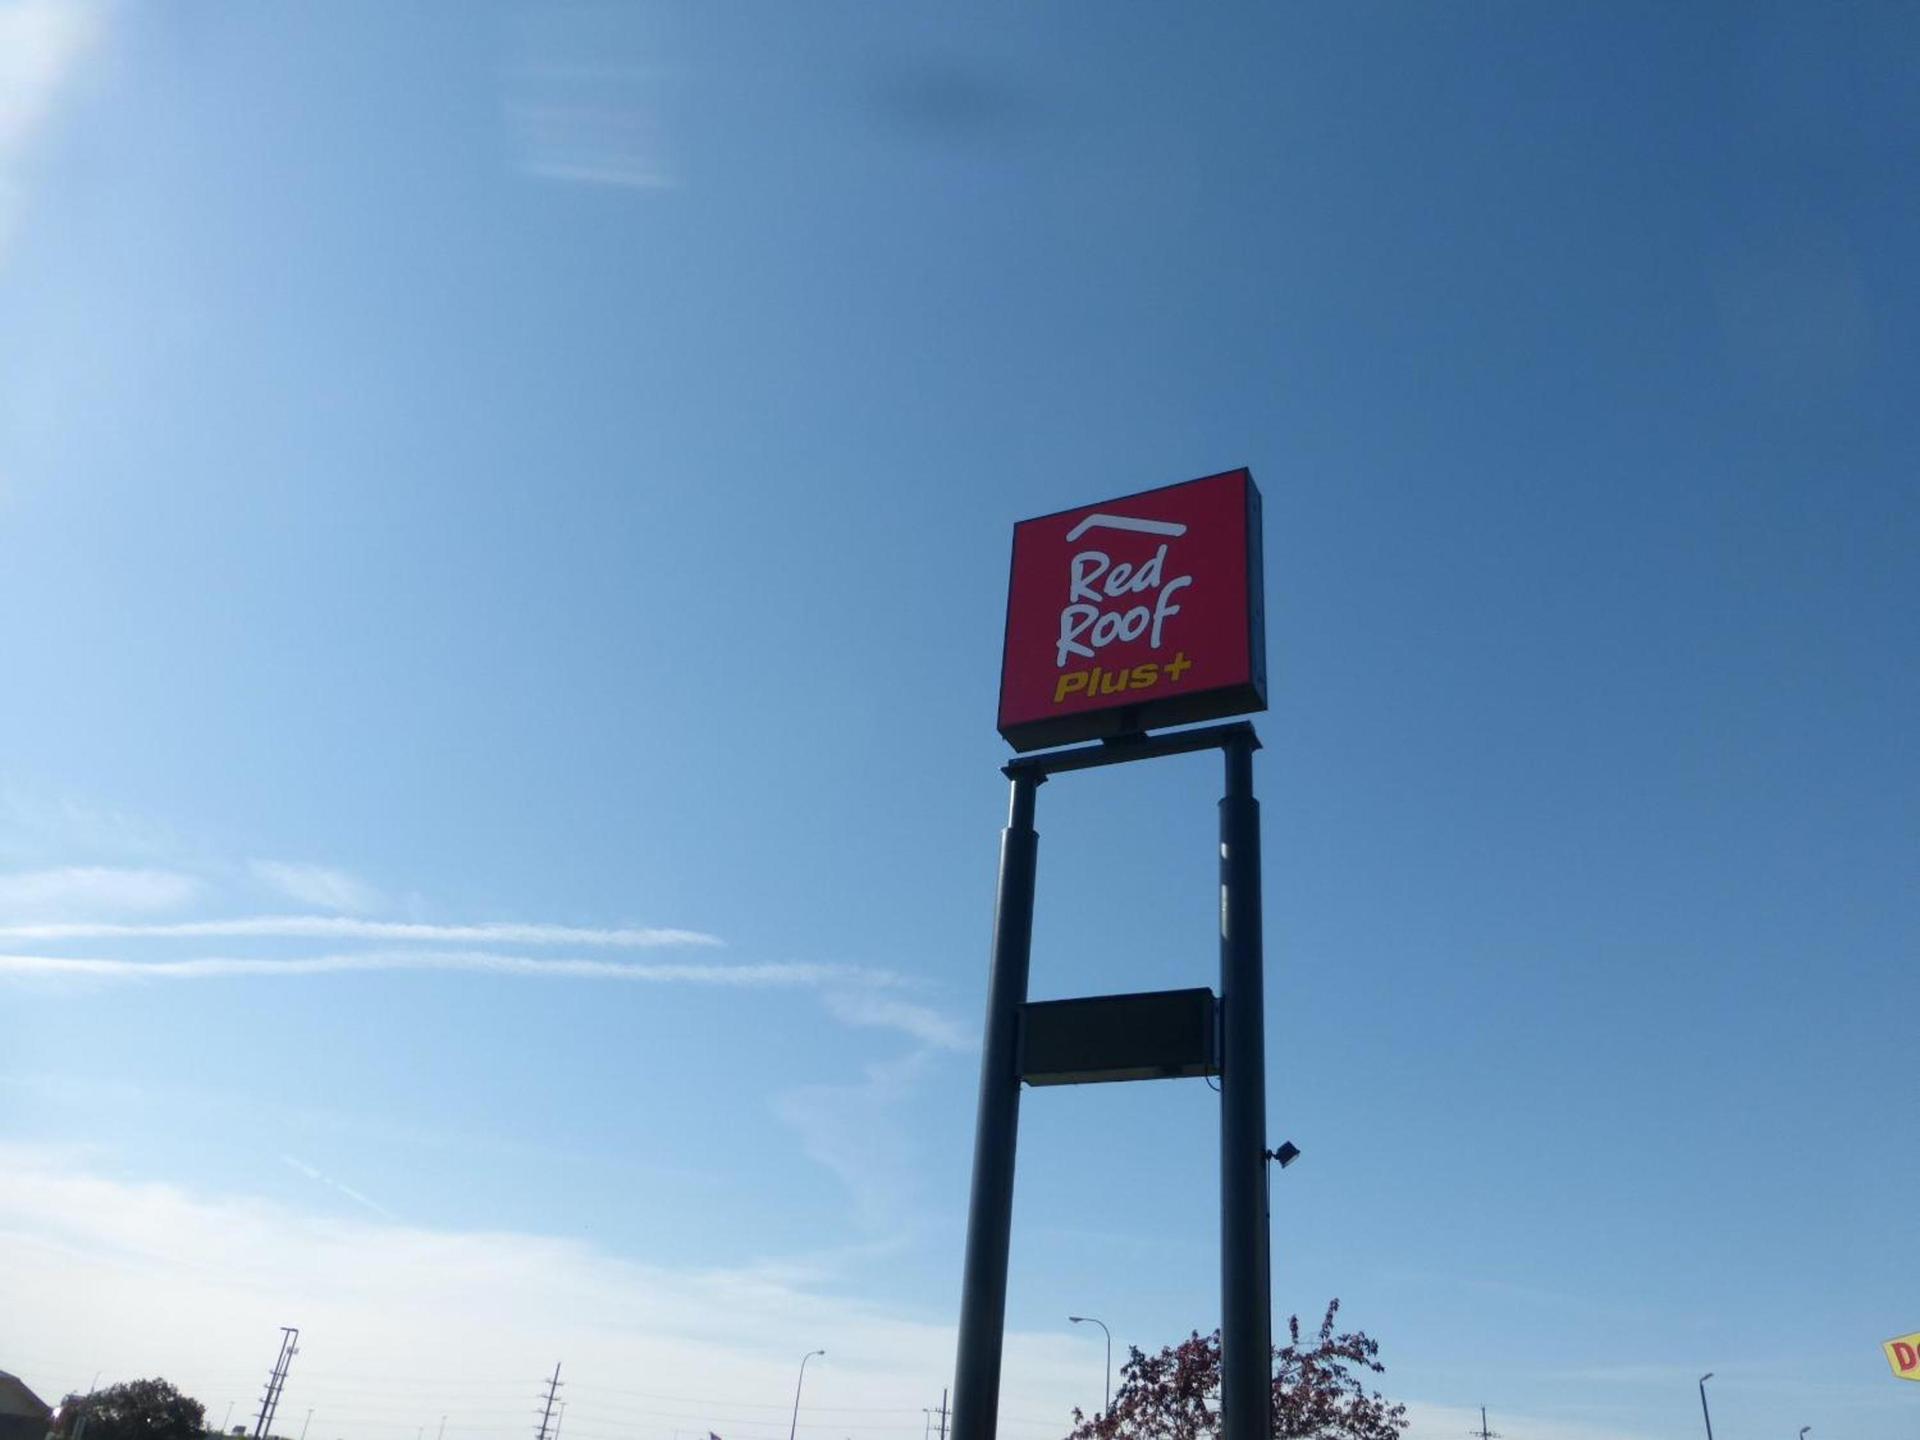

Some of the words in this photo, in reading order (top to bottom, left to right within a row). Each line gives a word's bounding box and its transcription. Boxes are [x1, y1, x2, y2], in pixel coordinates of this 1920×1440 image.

[1070, 544, 1168, 603] Red
[1056, 575, 1192, 667] Roof
[1053, 652, 1192, 703] Plus+
[1890, 1341, 1920, 1372] D
